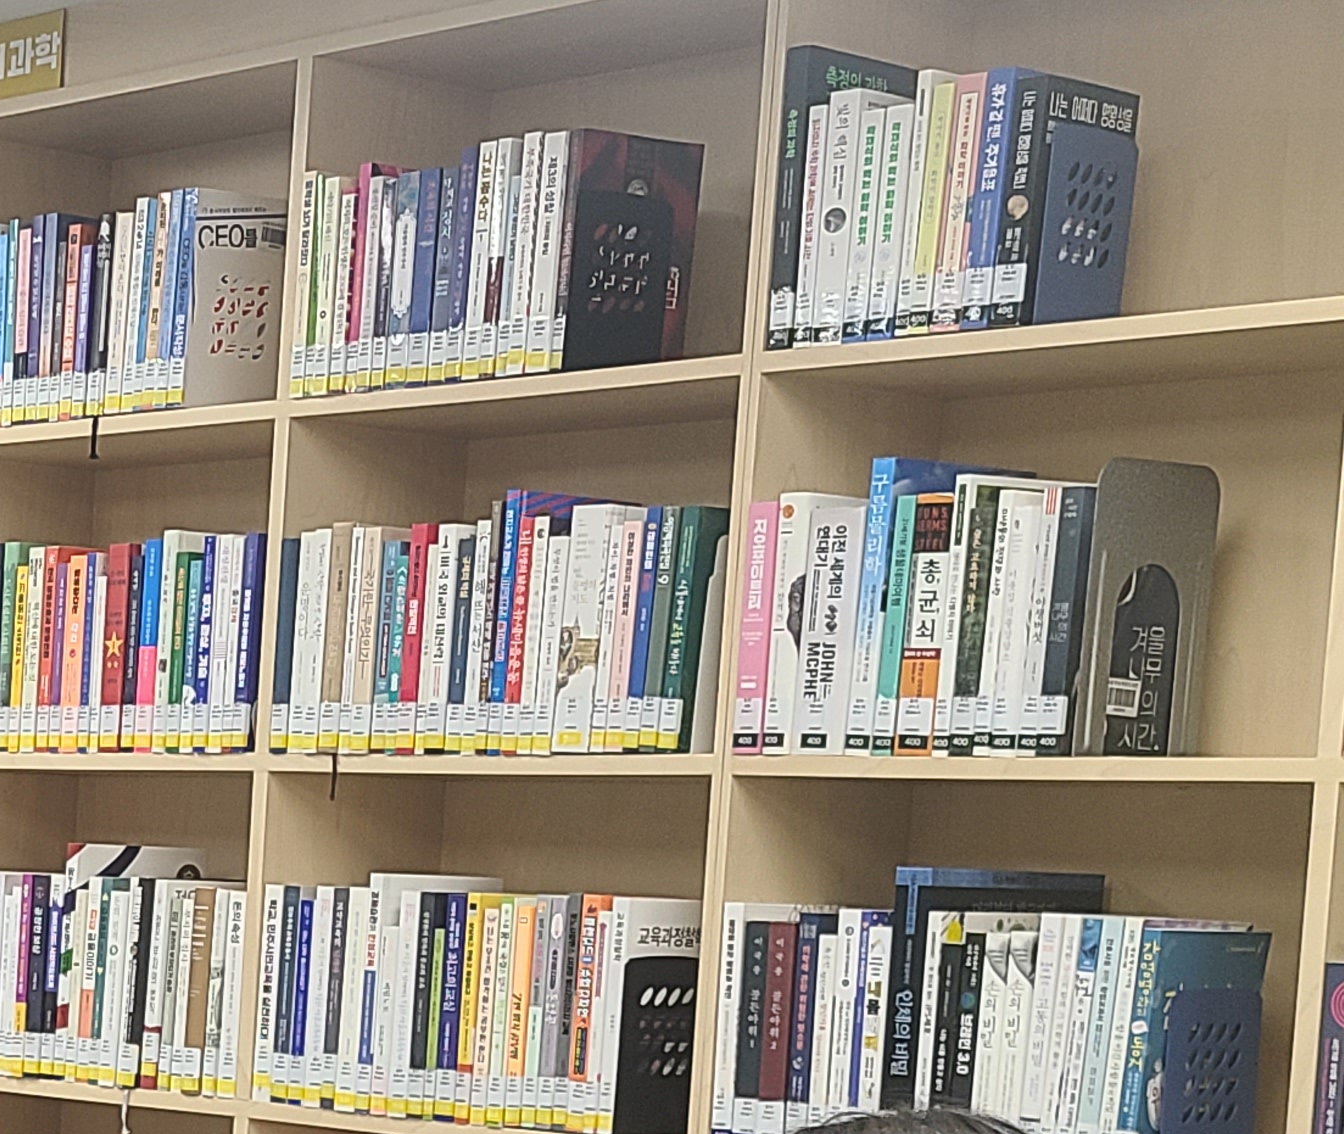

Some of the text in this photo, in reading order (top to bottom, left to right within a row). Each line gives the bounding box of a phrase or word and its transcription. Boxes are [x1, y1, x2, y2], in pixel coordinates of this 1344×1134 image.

[835, 104, 850, 129] 빛의
[988, 110, 1003, 122] 갈
[991, 83, 1007, 108] 휴가
[1022, 90, 1037, 107] 나는
[1020, 109, 1034, 132] 어쩌다
[544, 156, 559, 214] 제3의 성찰
[980, 144, 999, 192] 주기율표
[813, 525, 831, 568] 연대기
[827, 525, 848, 599] 이전 세계의
[433, 556, 451, 658] 미국 외교의 대전략
[915, 619, 936, 643] 쇠
[819, 641, 837, 683] JOHN
[231, 901, 242, 944] 돈의 속성
[266, 899, 277, 921] 학교,
[443, 952, 457, 1012] 최고의 교실
[890, 990, 913, 1077] 인체의 비밀
[956, 1014, 973, 1075] 브레인 3.0
